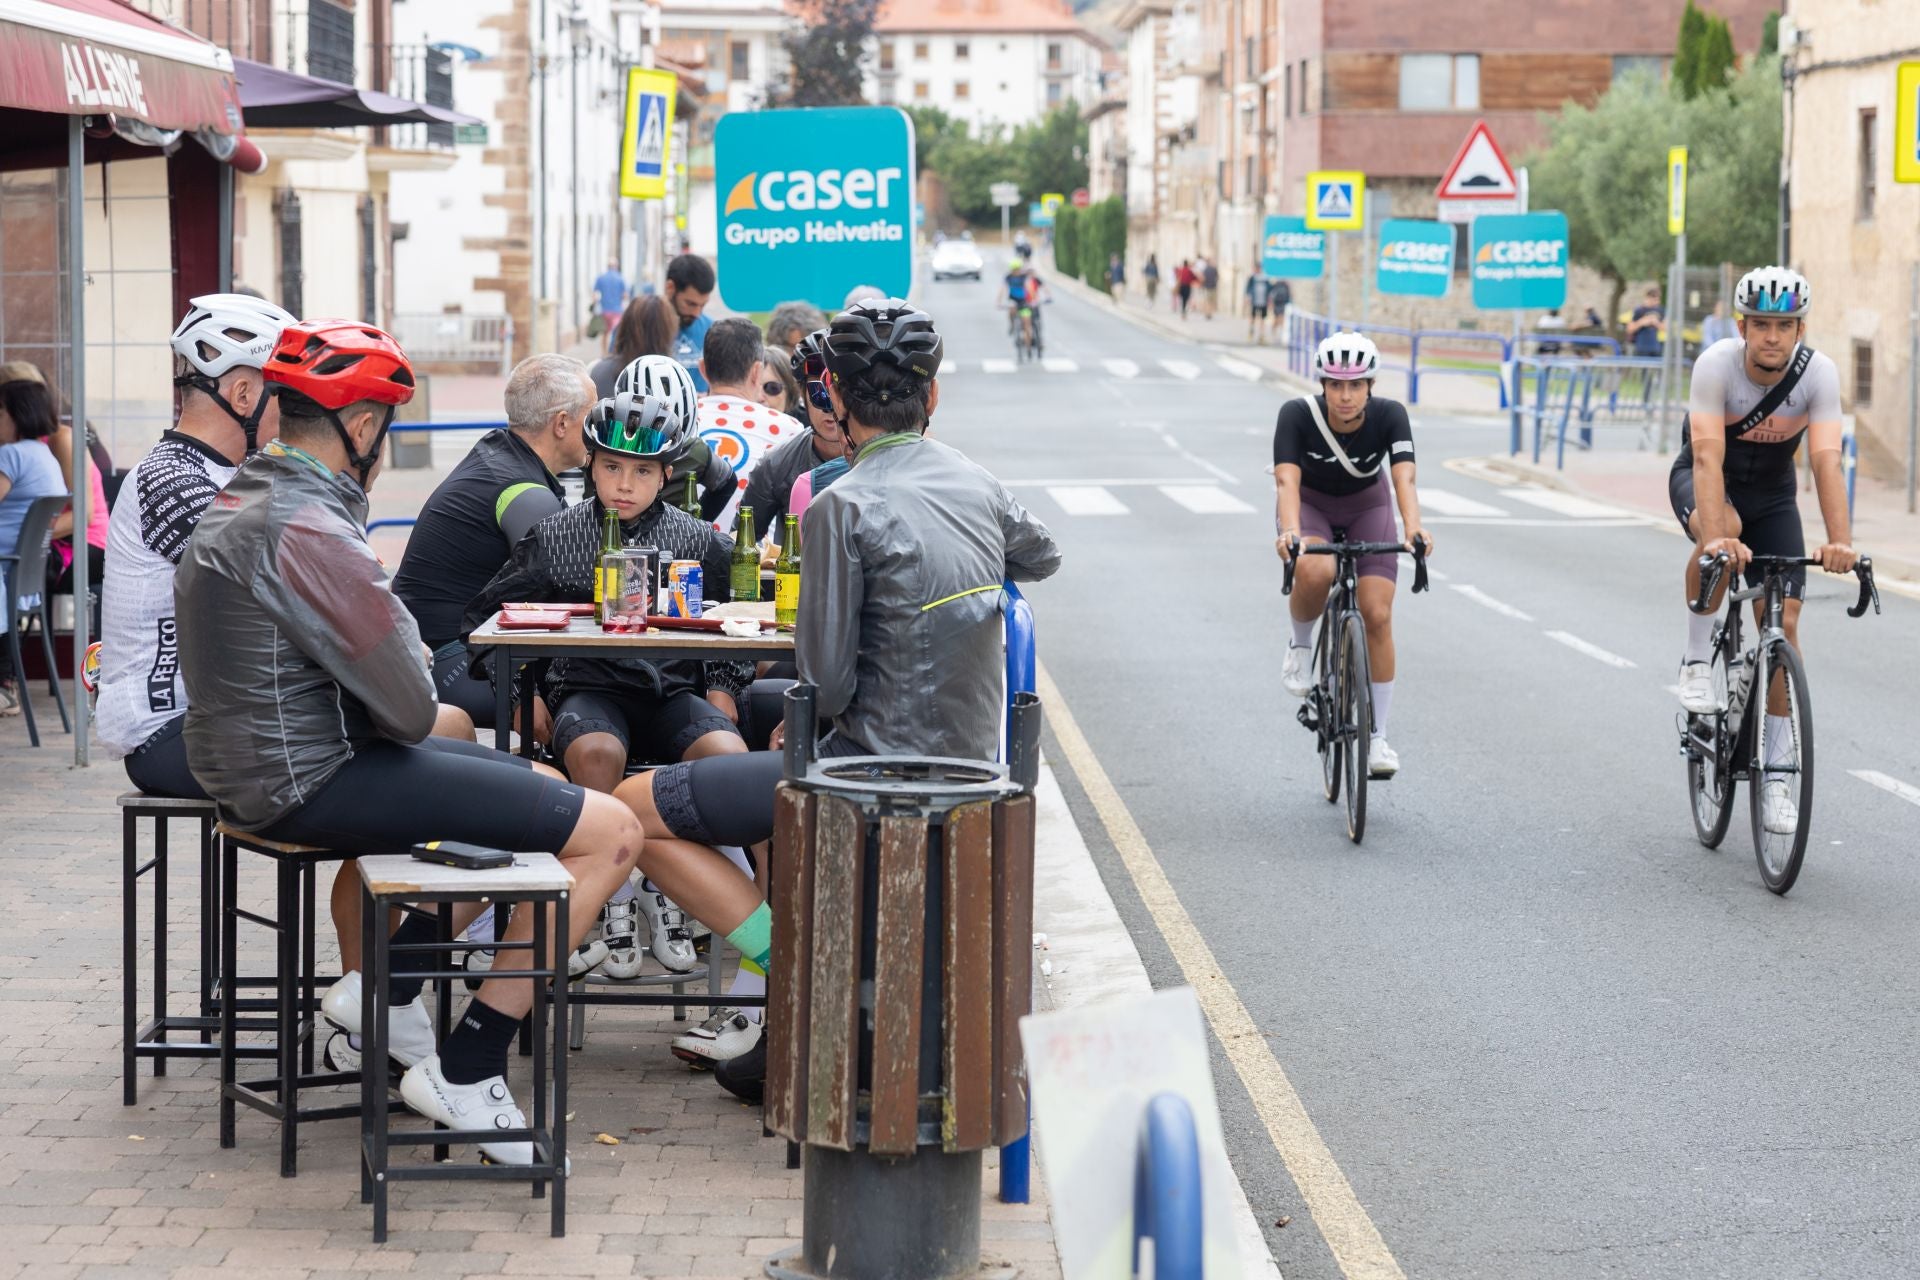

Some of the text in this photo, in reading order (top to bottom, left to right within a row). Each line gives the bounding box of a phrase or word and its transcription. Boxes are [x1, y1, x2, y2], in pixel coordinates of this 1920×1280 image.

[61, 42, 148, 117] ALLENDE
[758, 167, 902, 211] caser
[725, 219, 903, 250] Grupo Helvetia
[1493, 240, 1564, 263] caser
[154, 496, 178, 517] JOSÉ
[152, 687, 173, 711] LA
